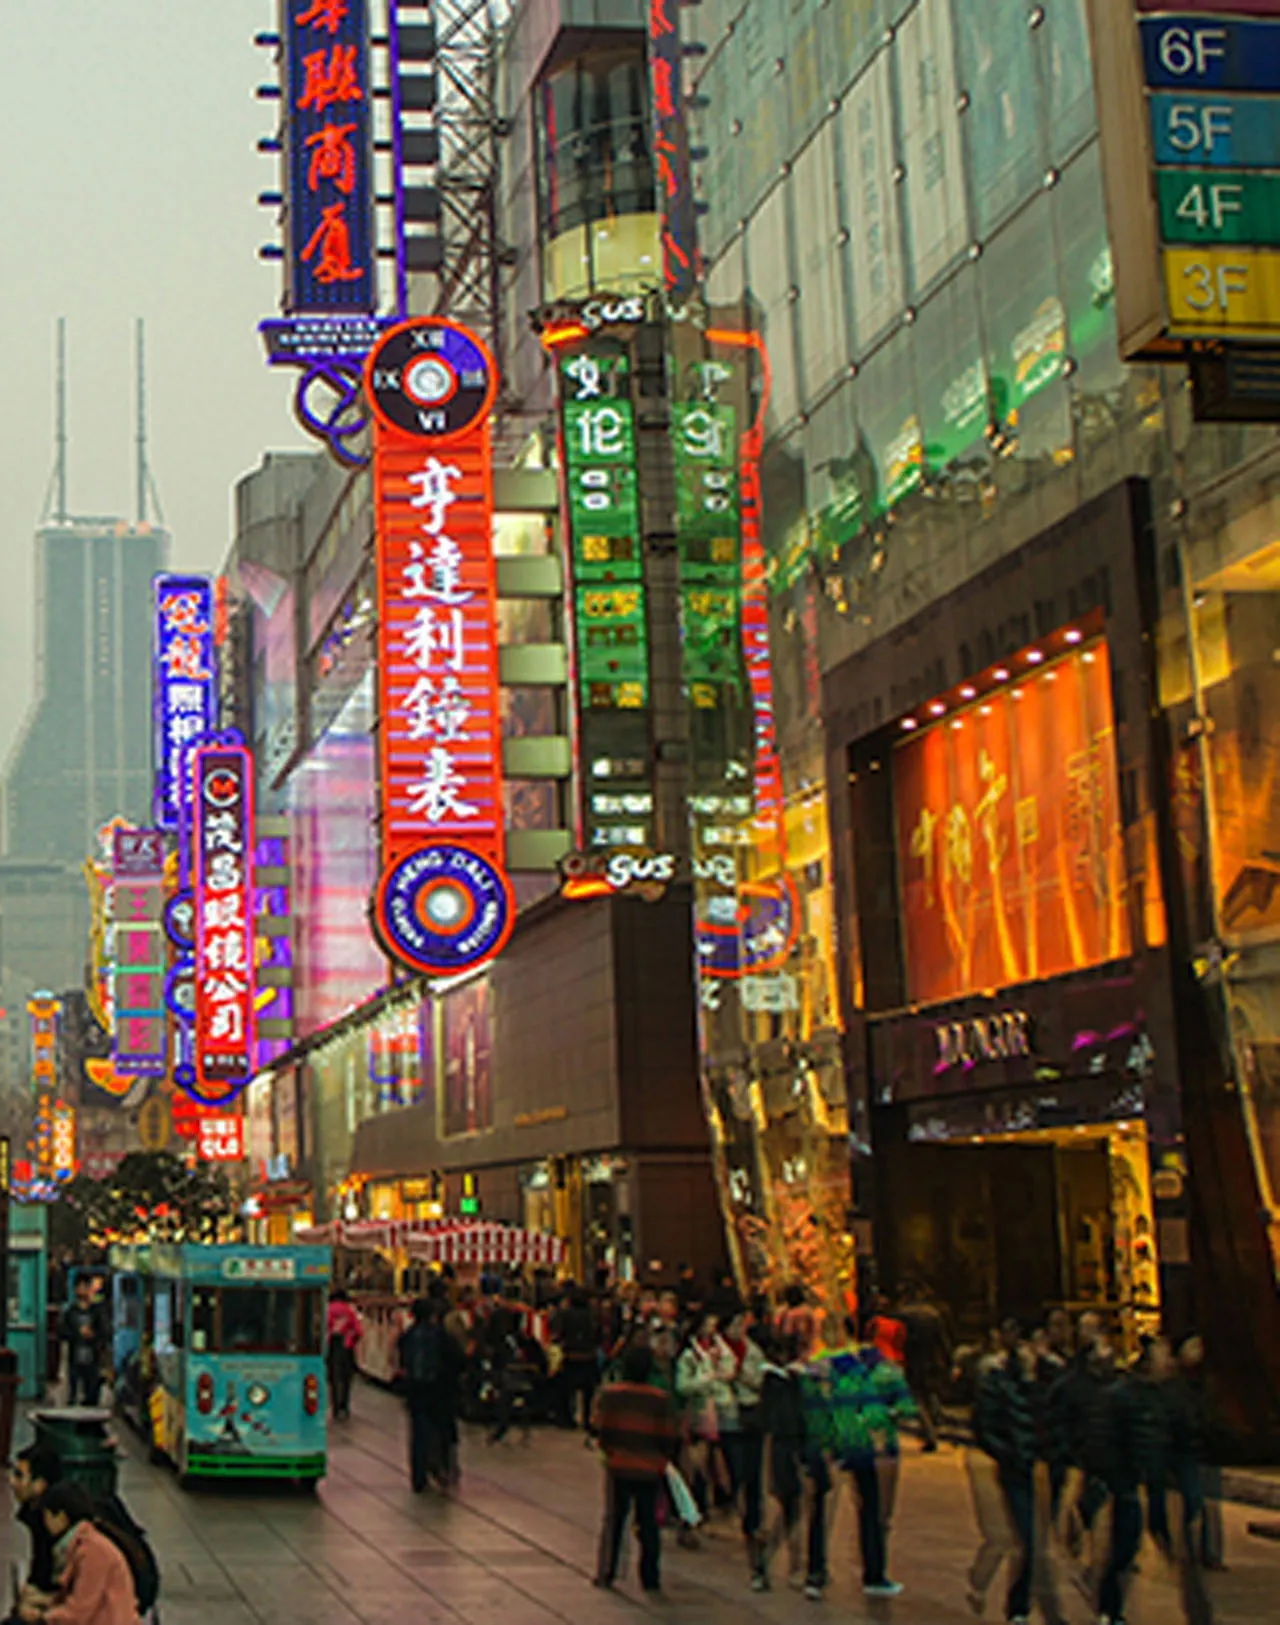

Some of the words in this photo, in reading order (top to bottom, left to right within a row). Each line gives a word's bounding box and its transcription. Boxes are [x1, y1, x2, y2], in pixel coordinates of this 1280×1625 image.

[1159, 27, 1228, 76] 6F
[1167, 104, 1234, 151] 5F
[1175, 183, 1243, 230] 4F
[1183, 262, 1249, 311] 3F
[417, 410, 447, 430] VI
